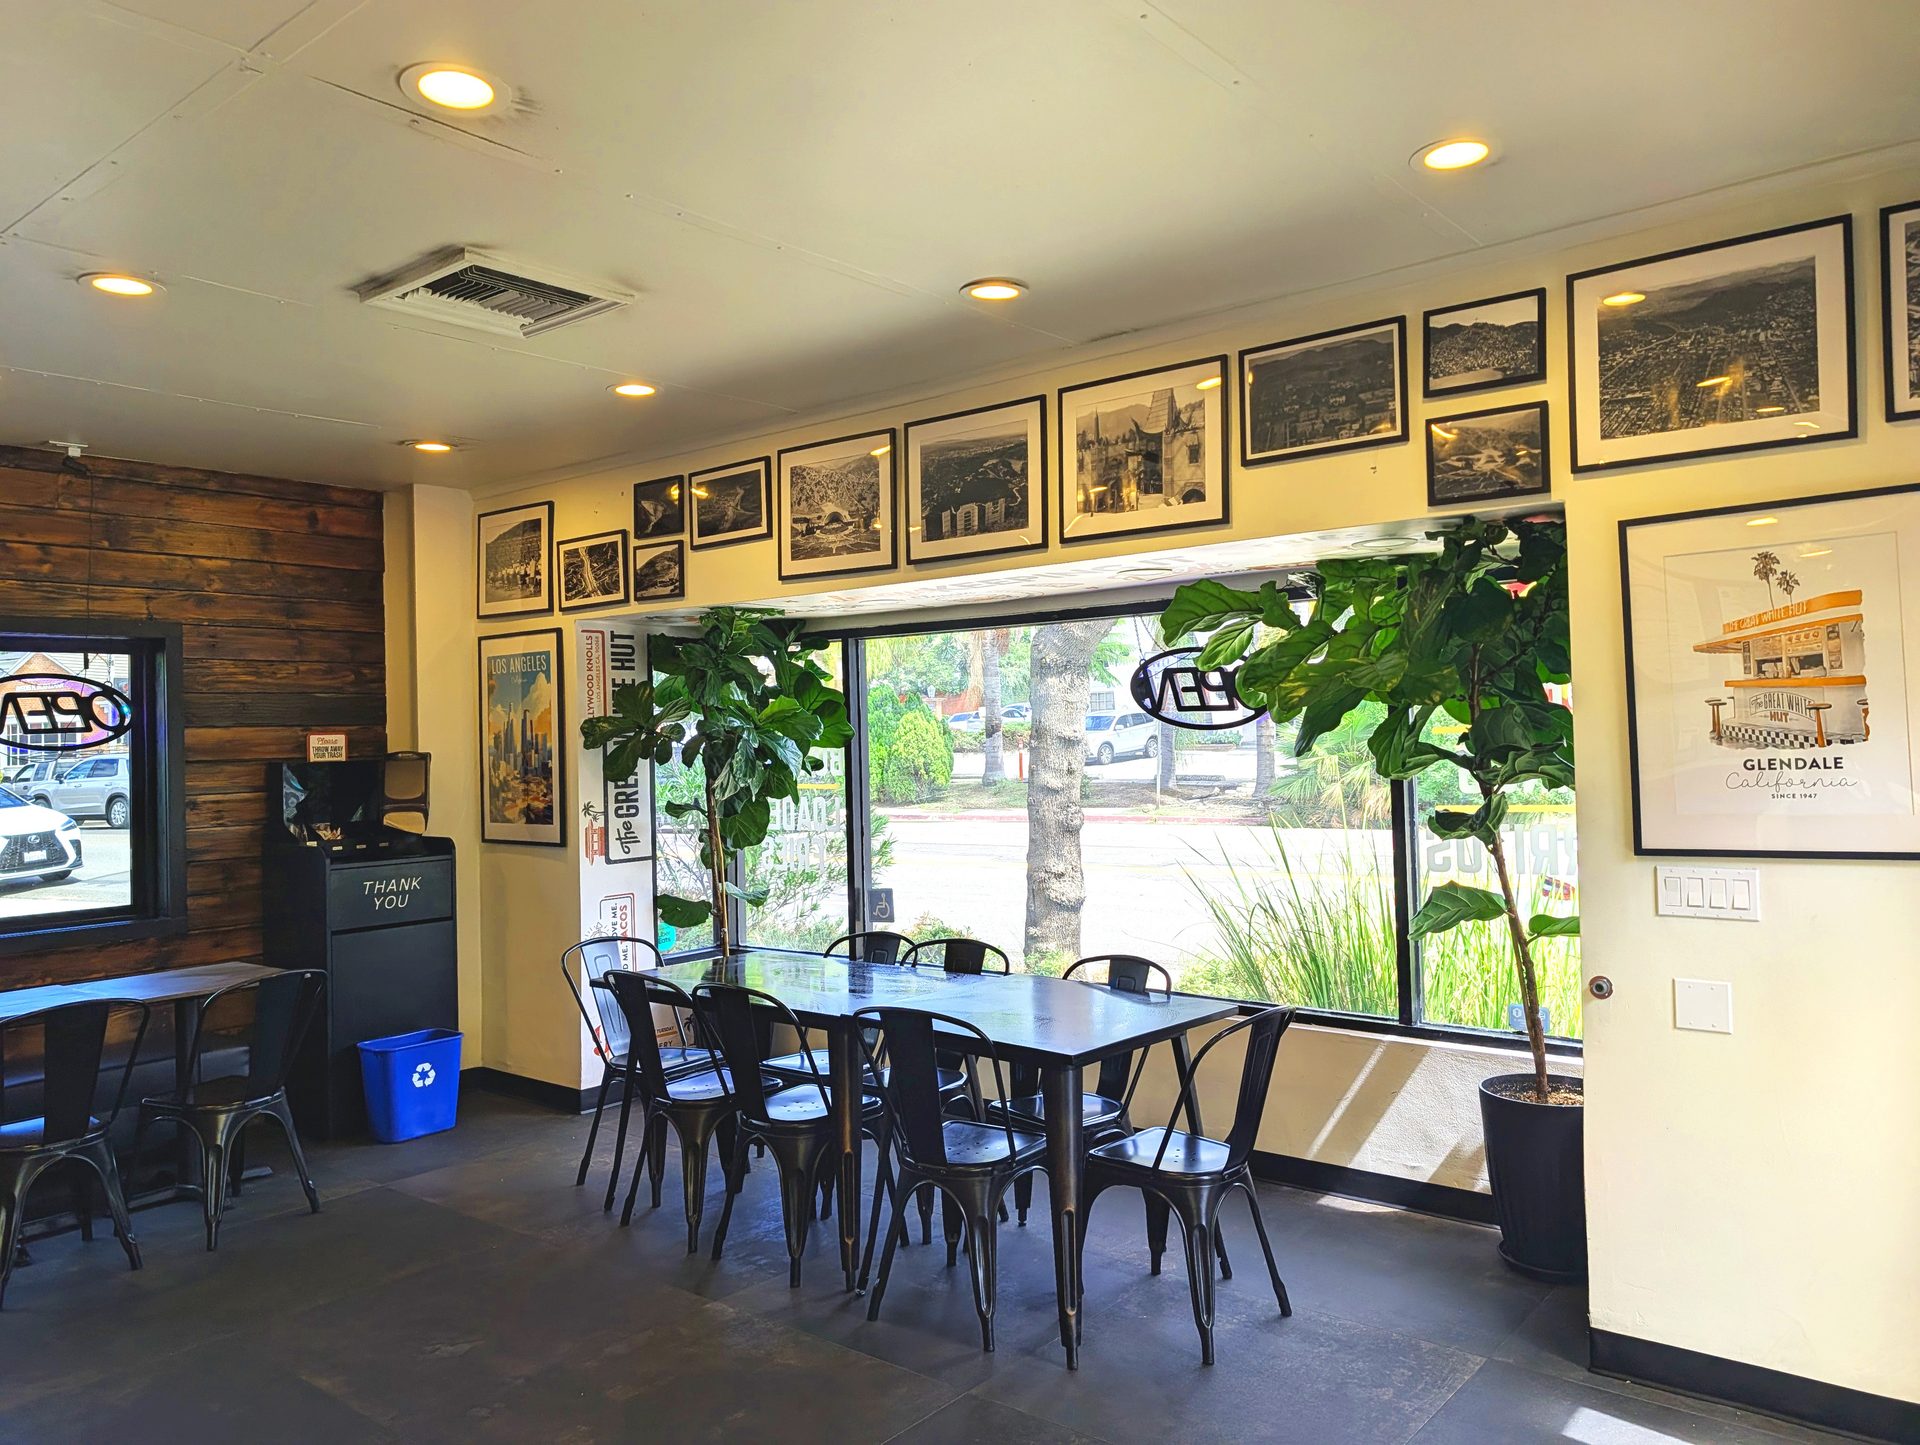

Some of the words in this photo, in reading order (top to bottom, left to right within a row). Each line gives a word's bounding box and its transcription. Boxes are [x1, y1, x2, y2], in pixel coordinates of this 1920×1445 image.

[585, 635, 594, 671] KNOLLS
[610, 630, 636, 671] HUT
[491, 658, 507, 675] LOS
[510, 654, 547, 673] ANGELES
[586, 675, 595, 718] LYWOOD
[1763, 693, 1785, 710] GREAT
[1769, 711, 1790, 723] HUT
[1743, 757, 1844, 771] GLENDALE
[1725, 771, 1858, 793] California
[615, 820, 641, 855] The
[363, 877, 422, 895] THANK
[374, 894, 409, 910] YOU
[620, 904, 628, 944] ACOS
[621, 945, 629, 961] ME.
